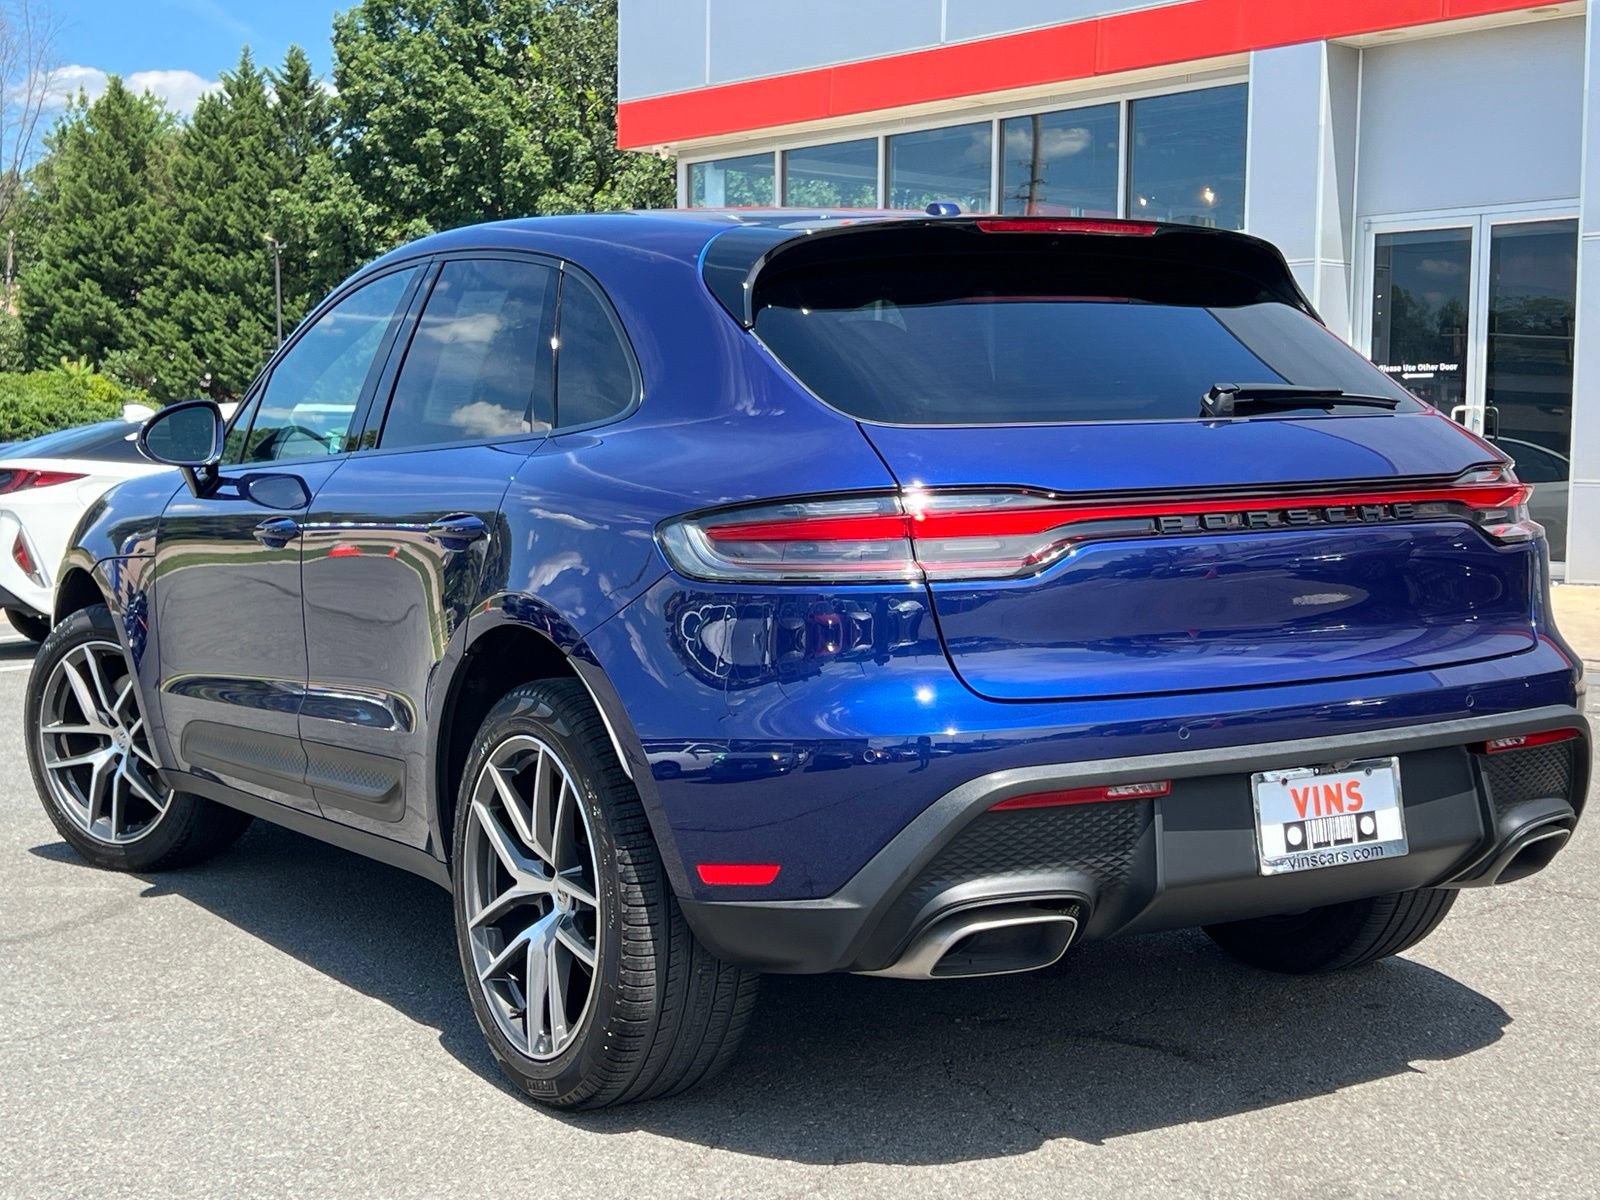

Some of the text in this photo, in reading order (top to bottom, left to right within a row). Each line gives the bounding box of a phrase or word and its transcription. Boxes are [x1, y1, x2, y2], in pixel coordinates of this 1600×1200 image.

[1403, 364, 1416, 372] Use
[1417, 363, 1439, 372] Other
[1440, 363, 1458, 371] Door
[1157, 503, 1415, 535] PORSCHE
[1290, 780, 1364, 818] VINS
[1288, 845, 1384, 870] vinscars.com
